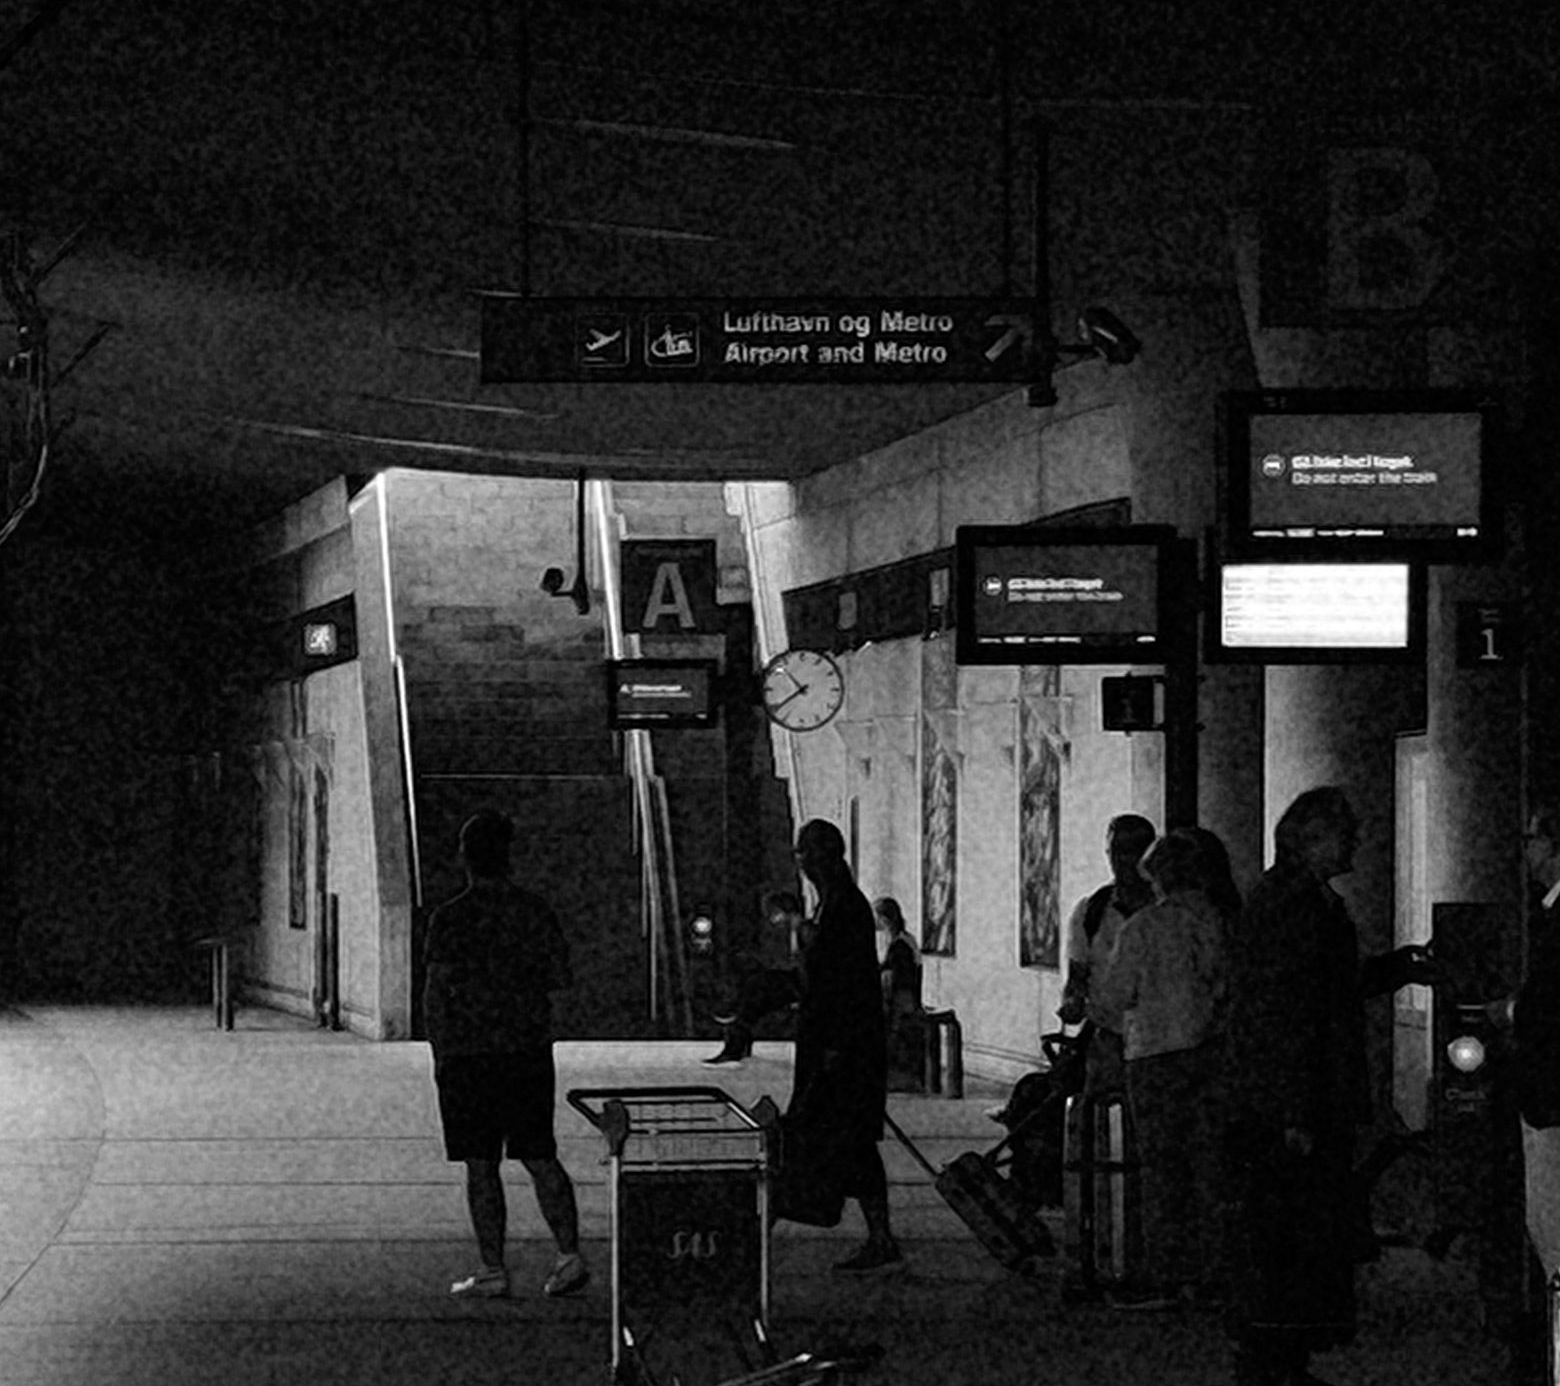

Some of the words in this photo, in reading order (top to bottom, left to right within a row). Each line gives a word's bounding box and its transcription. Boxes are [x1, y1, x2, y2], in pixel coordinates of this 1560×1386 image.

[1327, 148, 1439, 310] B
[723, 311, 830, 332] Lufthavn
[839, 315, 871, 338] og
[880, 311, 953, 333] Metro
[725, 341, 810, 365] Airport
[818, 341, 865, 363] and
[874, 341, 948, 363] Metro
[642, 562, 696, 629] A
[1479, 628, 1501, 660] 1
